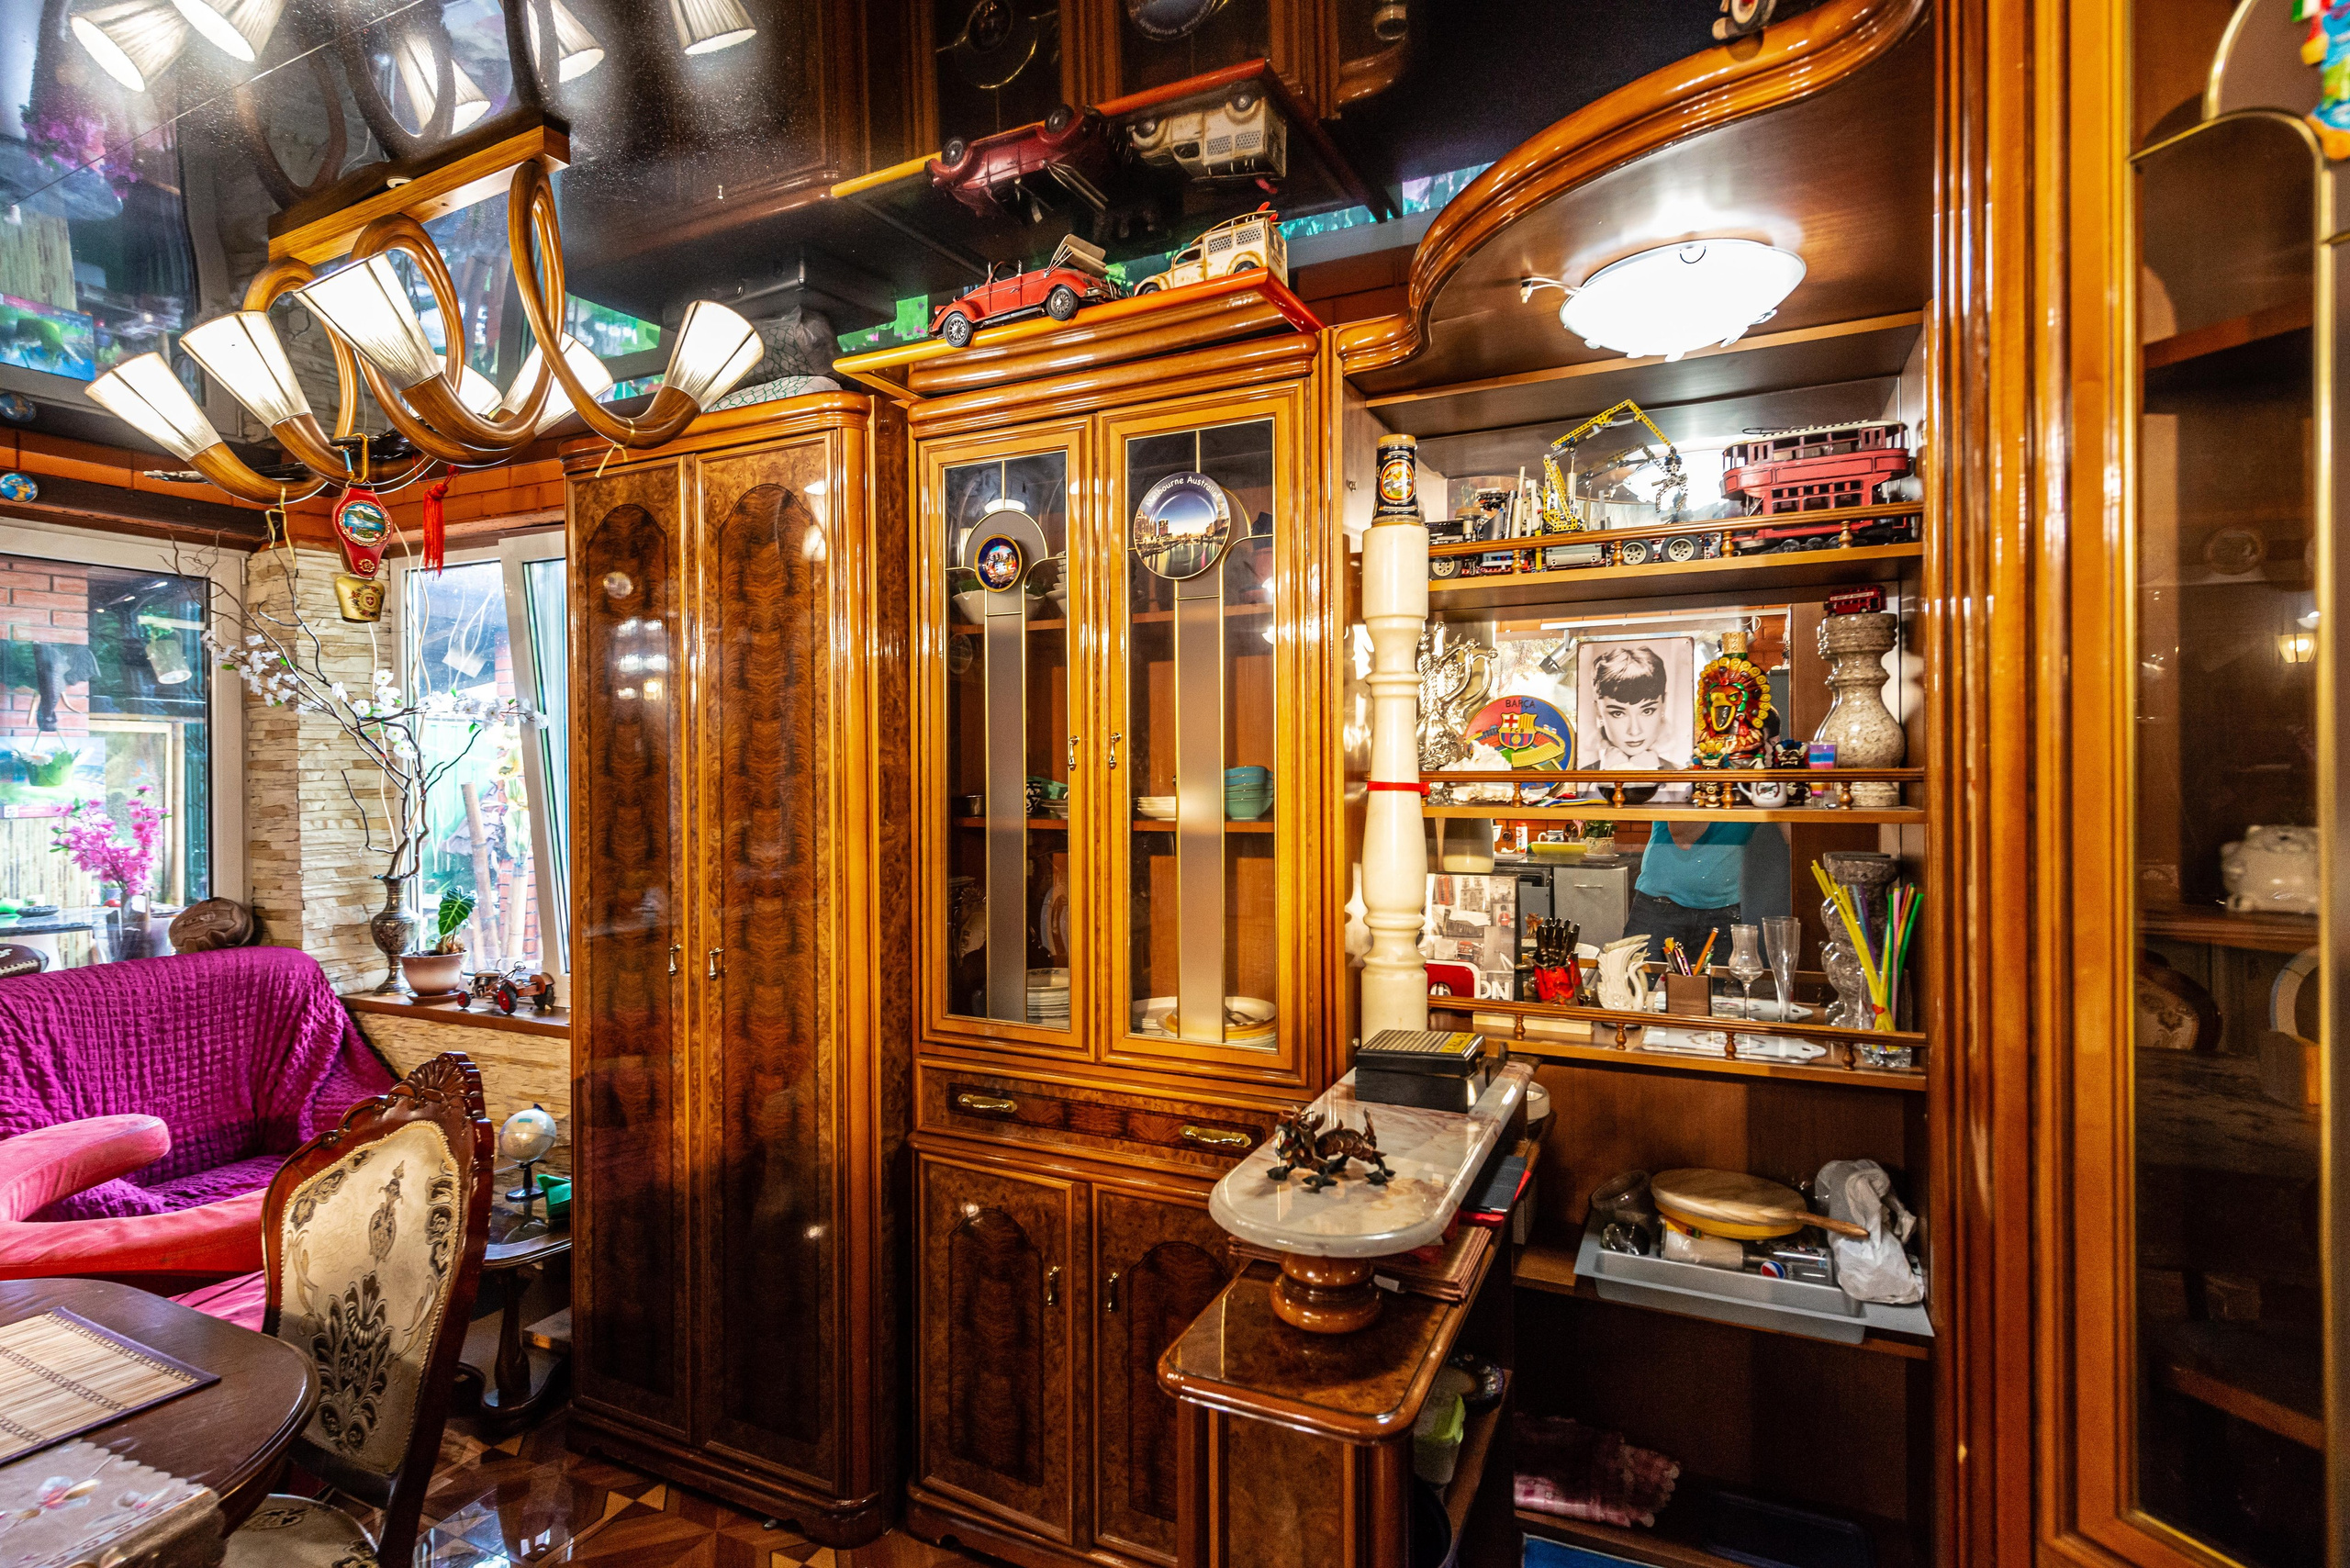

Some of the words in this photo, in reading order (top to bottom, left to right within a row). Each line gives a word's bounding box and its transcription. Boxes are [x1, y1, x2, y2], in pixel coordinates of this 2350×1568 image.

[1146, 477, 1184, 508] Melbourne
[1187, 476, 1218, 498] Australia
[1505, 700, 1536, 710] BARÇA
